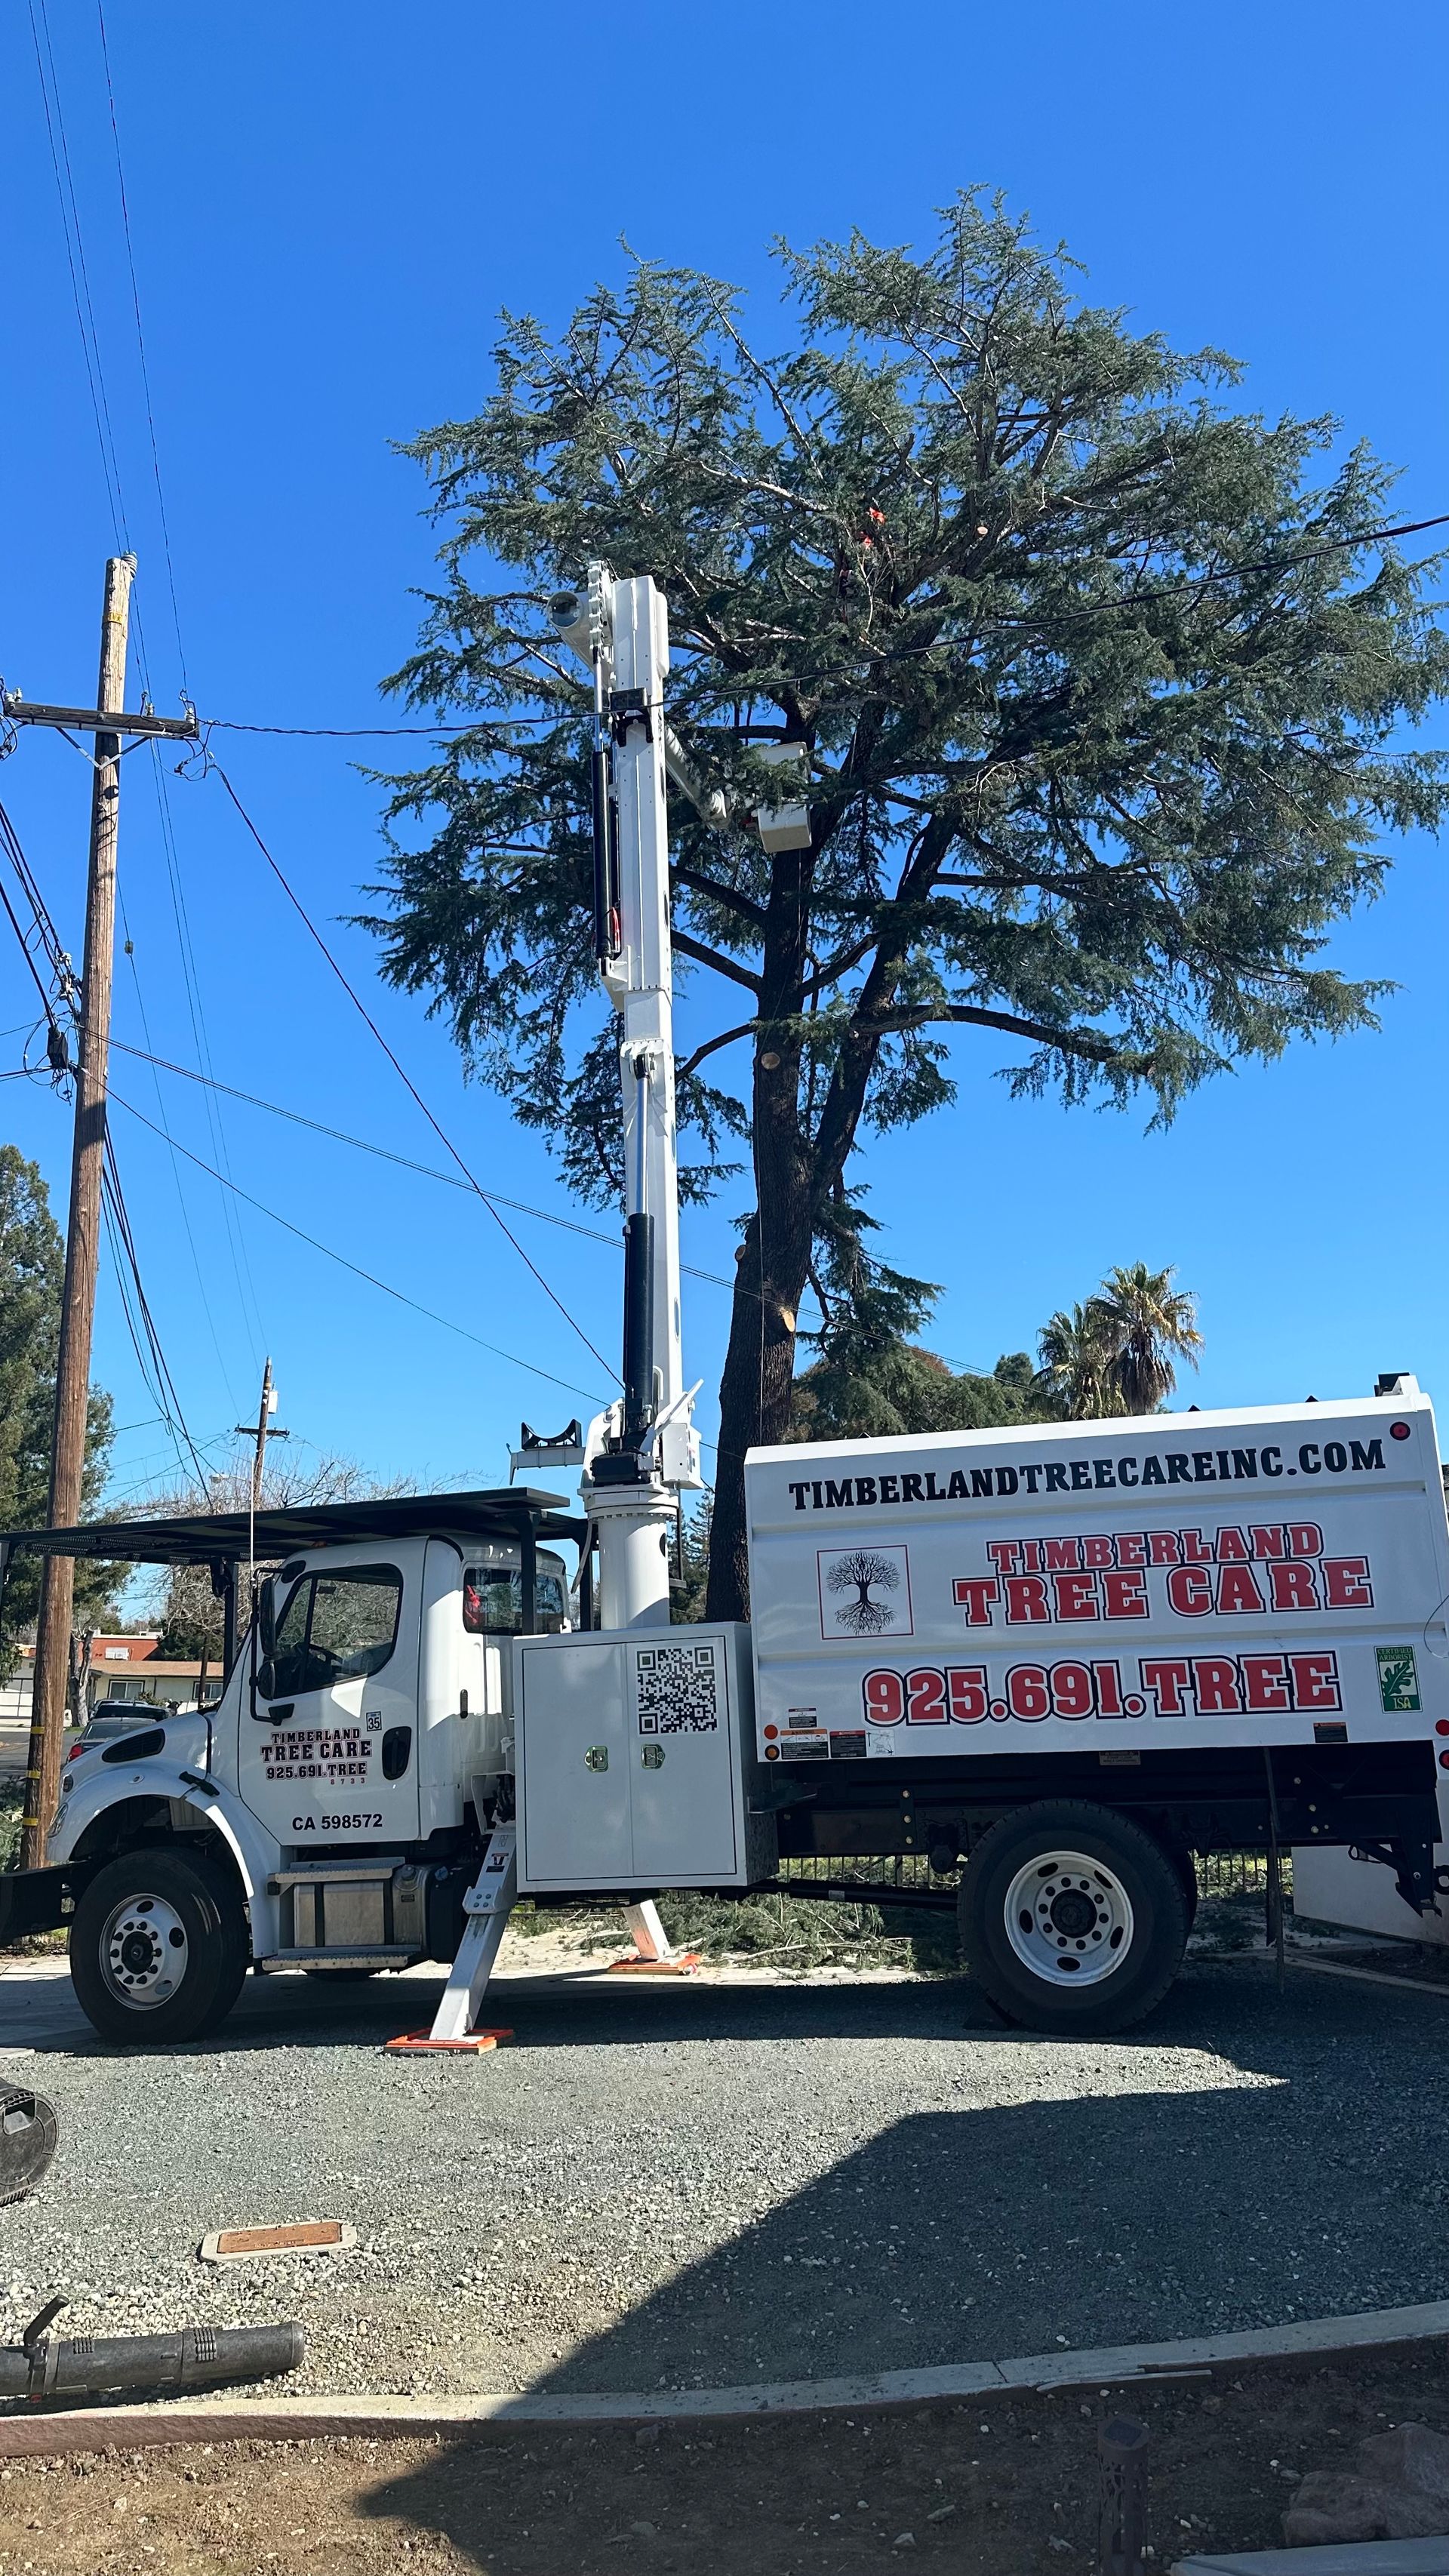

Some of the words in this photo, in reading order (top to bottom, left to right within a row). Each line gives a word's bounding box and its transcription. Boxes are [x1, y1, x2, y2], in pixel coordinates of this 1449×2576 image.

[789, 1439, 1386, 1510] TIMBERLANDTREECAREINC.COM
[986, 1522, 1324, 1575] TIMBERLAND
[952, 1568, 1149, 1627] TREE
[1167, 1556, 1374, 1617] CARE
[862, 1650, 1343, 1726] 925.691.TREE
[1393, 1697, 1412, 1710] ISA
[368, 1717, 380, 1729] 35
[272, 1728, 361, 1743] TIMBERLAND
[261, 1744, 313, 1762] TREE
[320, 1740, 372, 1759] CARE
[266, 1762, 367, 1780] 925.691.TREE
[292, 1817, 315, 1830] CA
[321, 1814, 383, 1830] 598572
